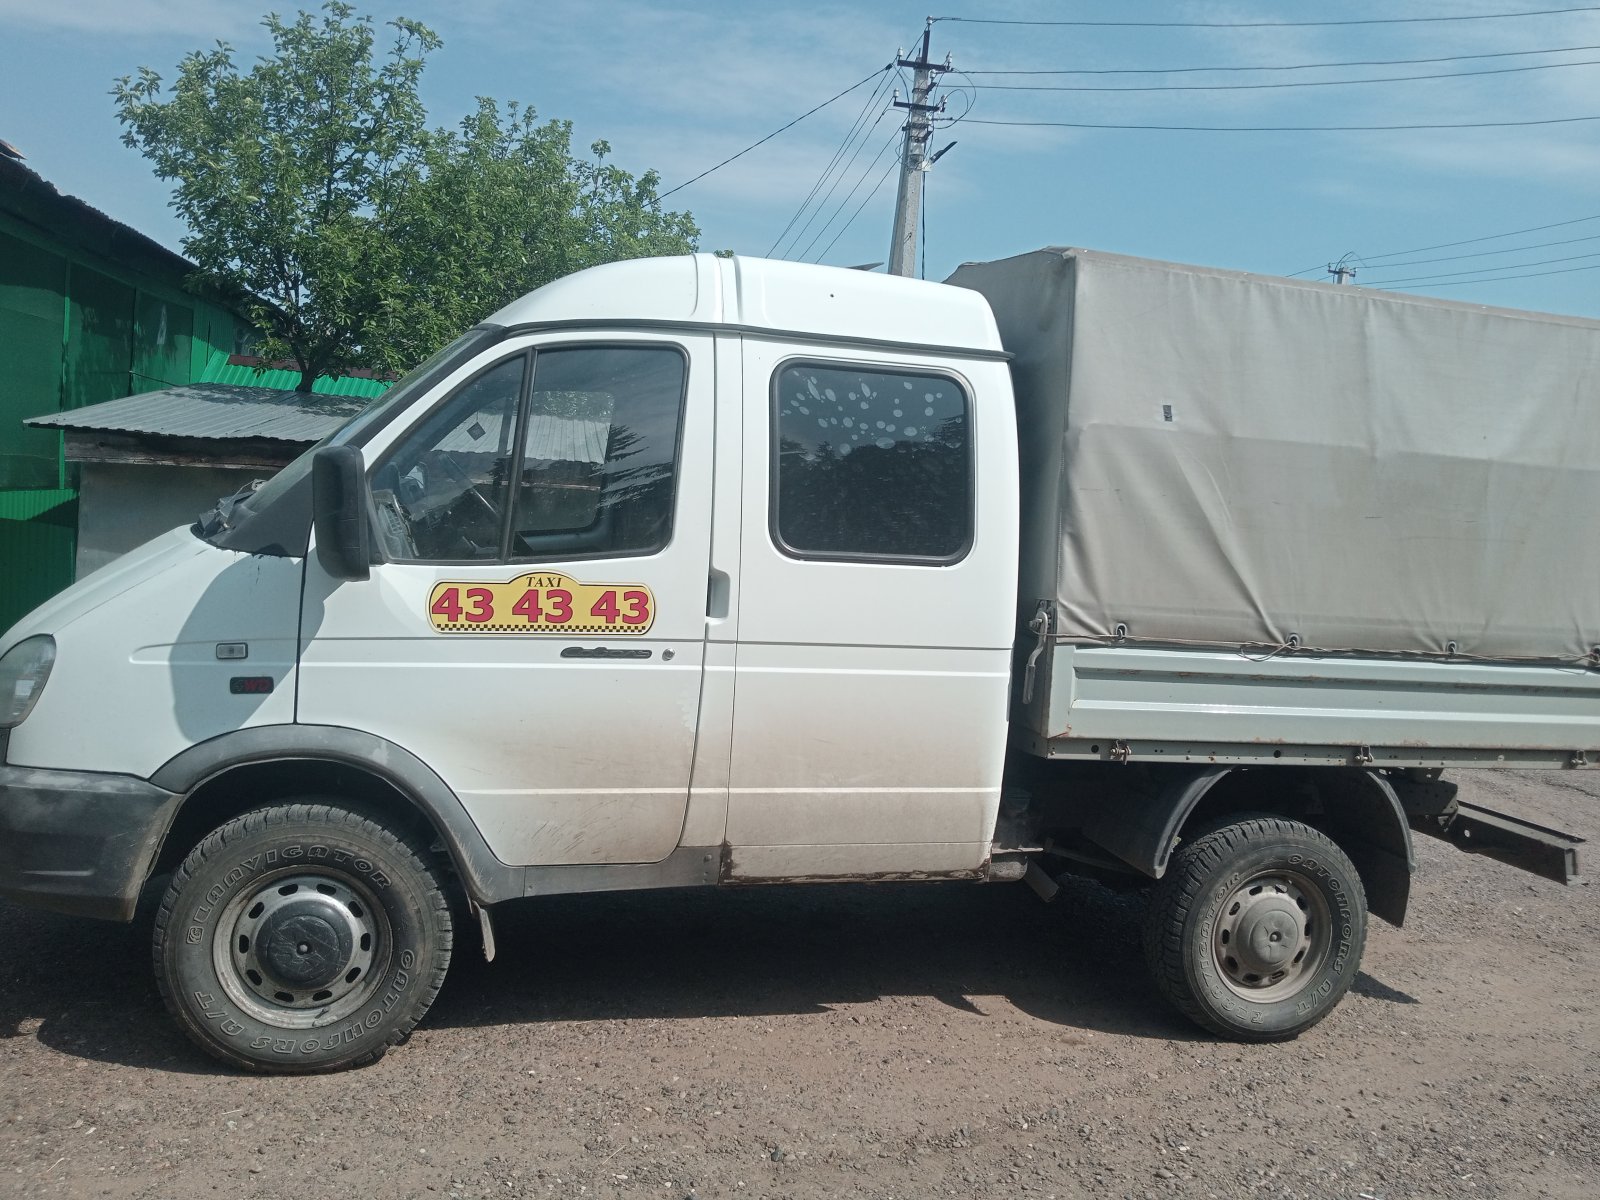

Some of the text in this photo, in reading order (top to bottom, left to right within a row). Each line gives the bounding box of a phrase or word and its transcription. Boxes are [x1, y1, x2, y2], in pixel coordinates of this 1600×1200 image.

[526, 576, 563, 588] TAXI
[431, 587, 650, 625] 43 43 43
[194, 991, 246, 1036] A/T
